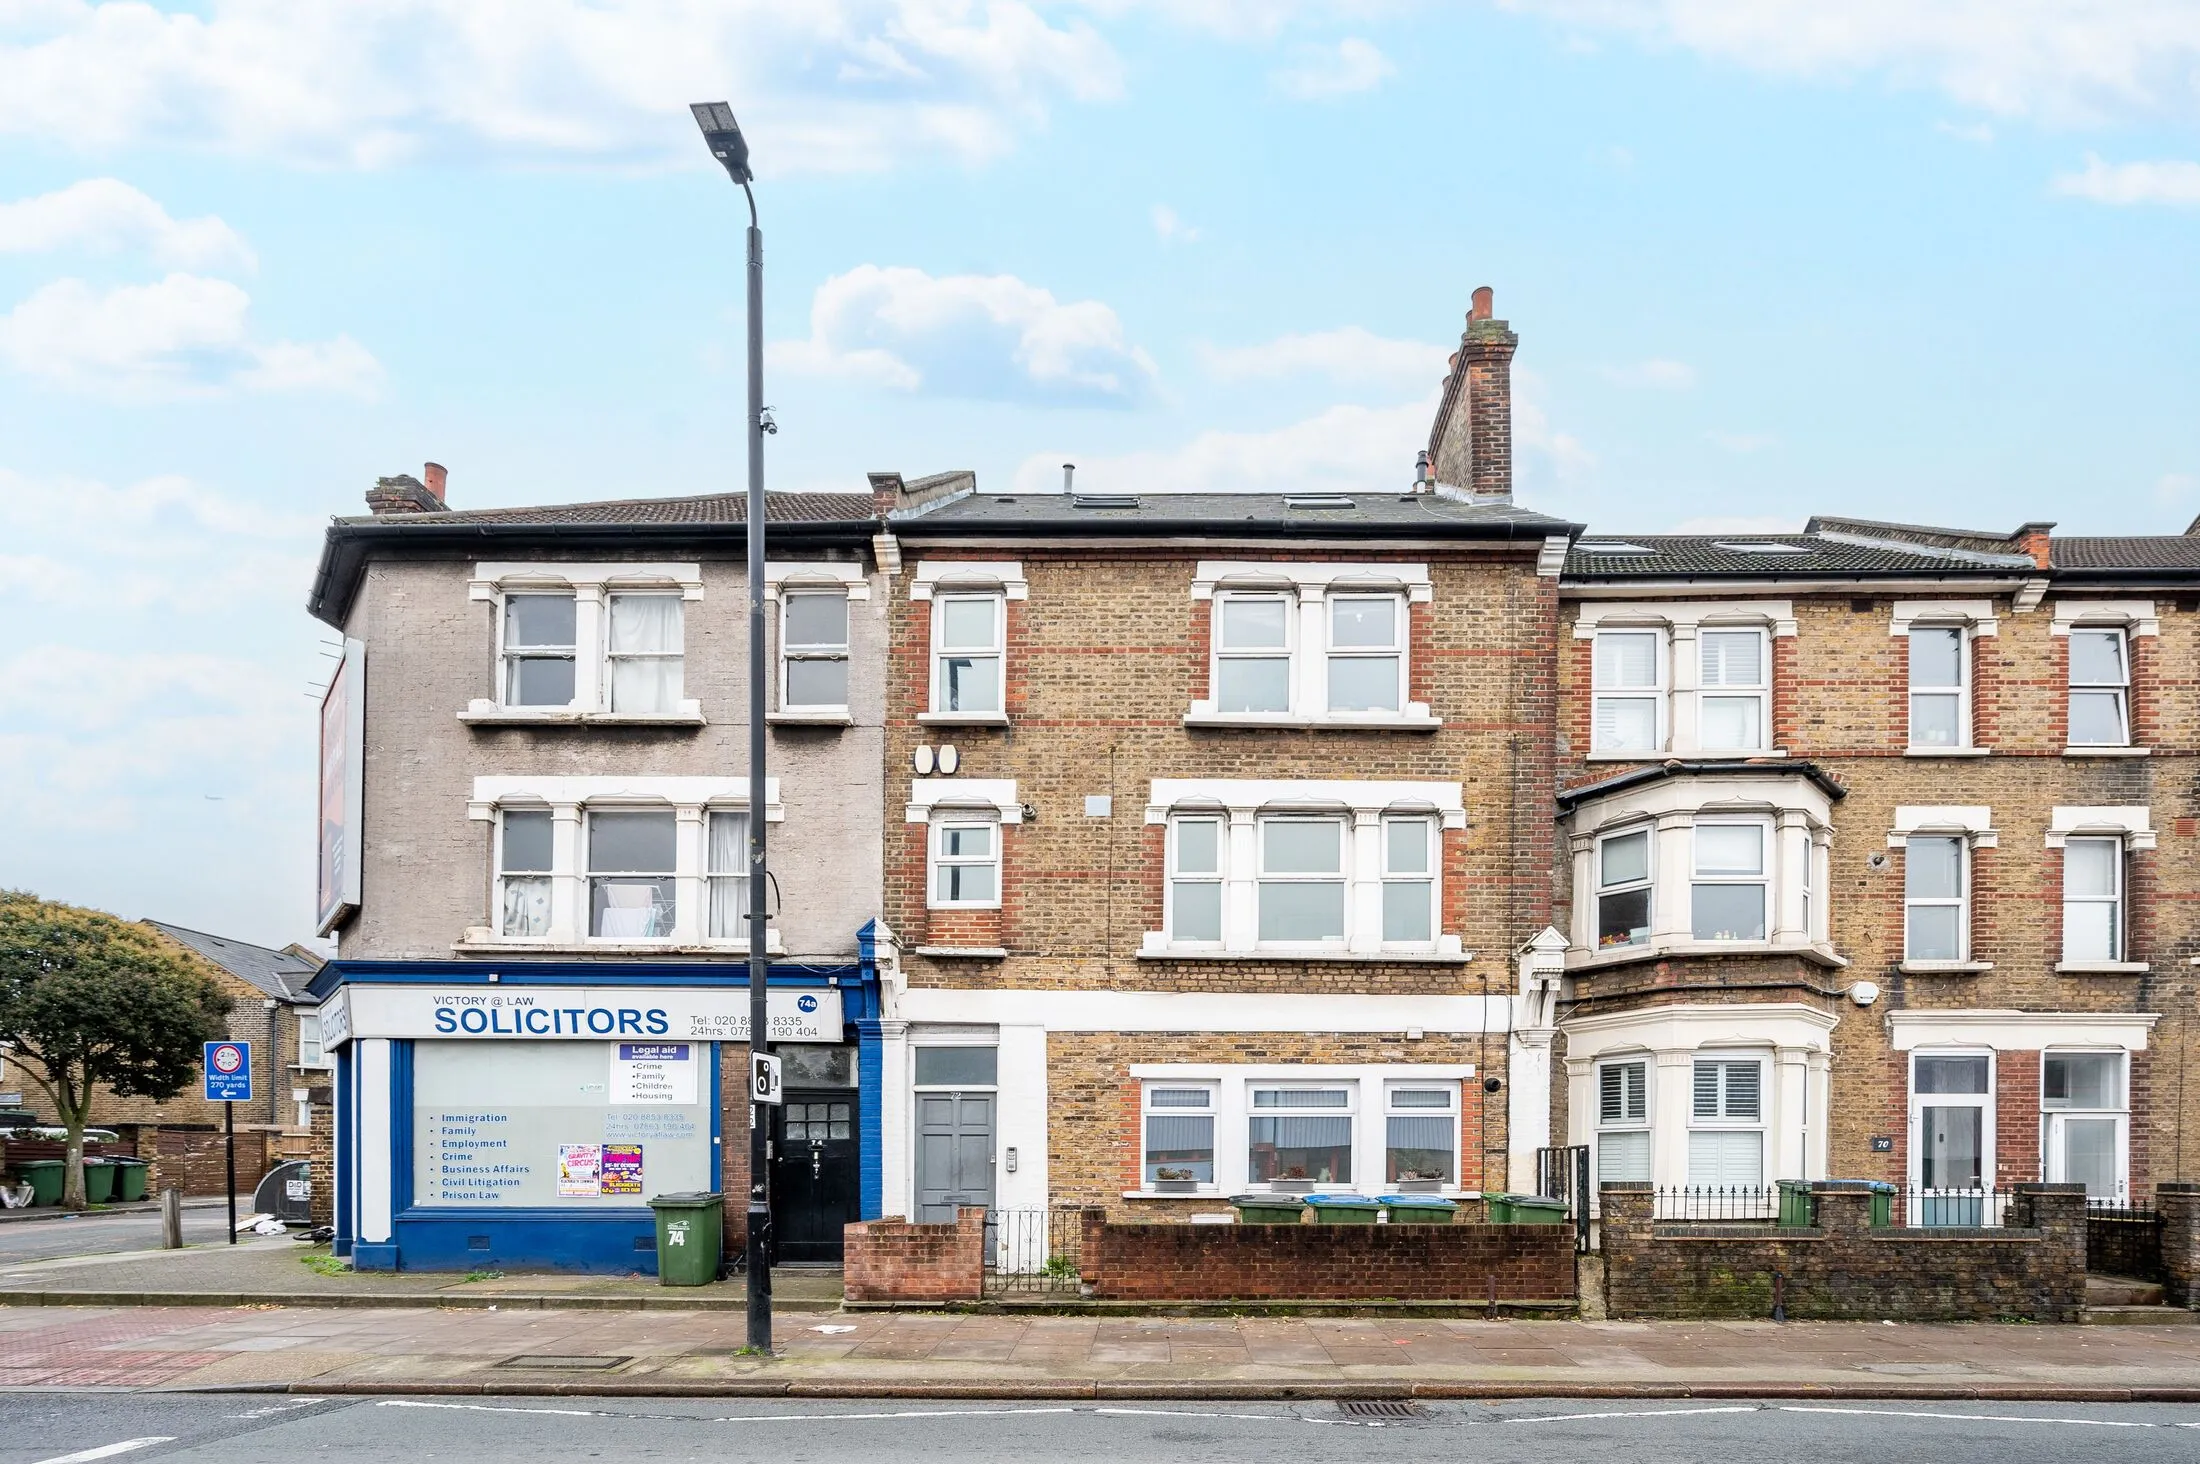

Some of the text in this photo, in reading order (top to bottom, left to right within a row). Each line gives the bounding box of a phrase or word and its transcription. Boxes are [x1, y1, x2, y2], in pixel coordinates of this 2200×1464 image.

[433, 996, 534, 1007] VICTORY @ LAW
[799, 1000, 817, 1008] 74a
[434, 1007, 669, 1035] SOLICITORS
[690, 1015, 711, 1026] Tel:
[714, 1015, 737, 1026] 020
[773, 1016, 803, 1027] 8335
[690, 1026, 727, 1036] 24hrs:
[771, 1027, 793, 1037] 190
[796, 1027, 818, 1037] 404
[632, 1045, 677, 1056] Legal aid
[636, 1062, 663, 1070] Crime
[636, 1072, 665, 1081] Family
[226, 1082, 246, 1090] yards
[636, 1082, 673, 1090] Children
[635, 1092, 673, 1101] Housing
[441, 1114, 508, 1124] Immigration
[441, 1127, 477, 1136] Family
[441, 1140, 507, 1149] Employment
[1877, 1140, 1890, 1148] 70
[441, 1152, 473, 1161] Crime
[567, 1152, 595, 1160] GRAVITY
[566, 1159, 595, 1167] CIRCUS
[441, 1165, 530, 1174] Business Affairs
[441, 1178, 520, 1188] Civil Litigation
[441, 1191, 500, 1199] Prison Law
[668, 1230, 685, 1247] 74
